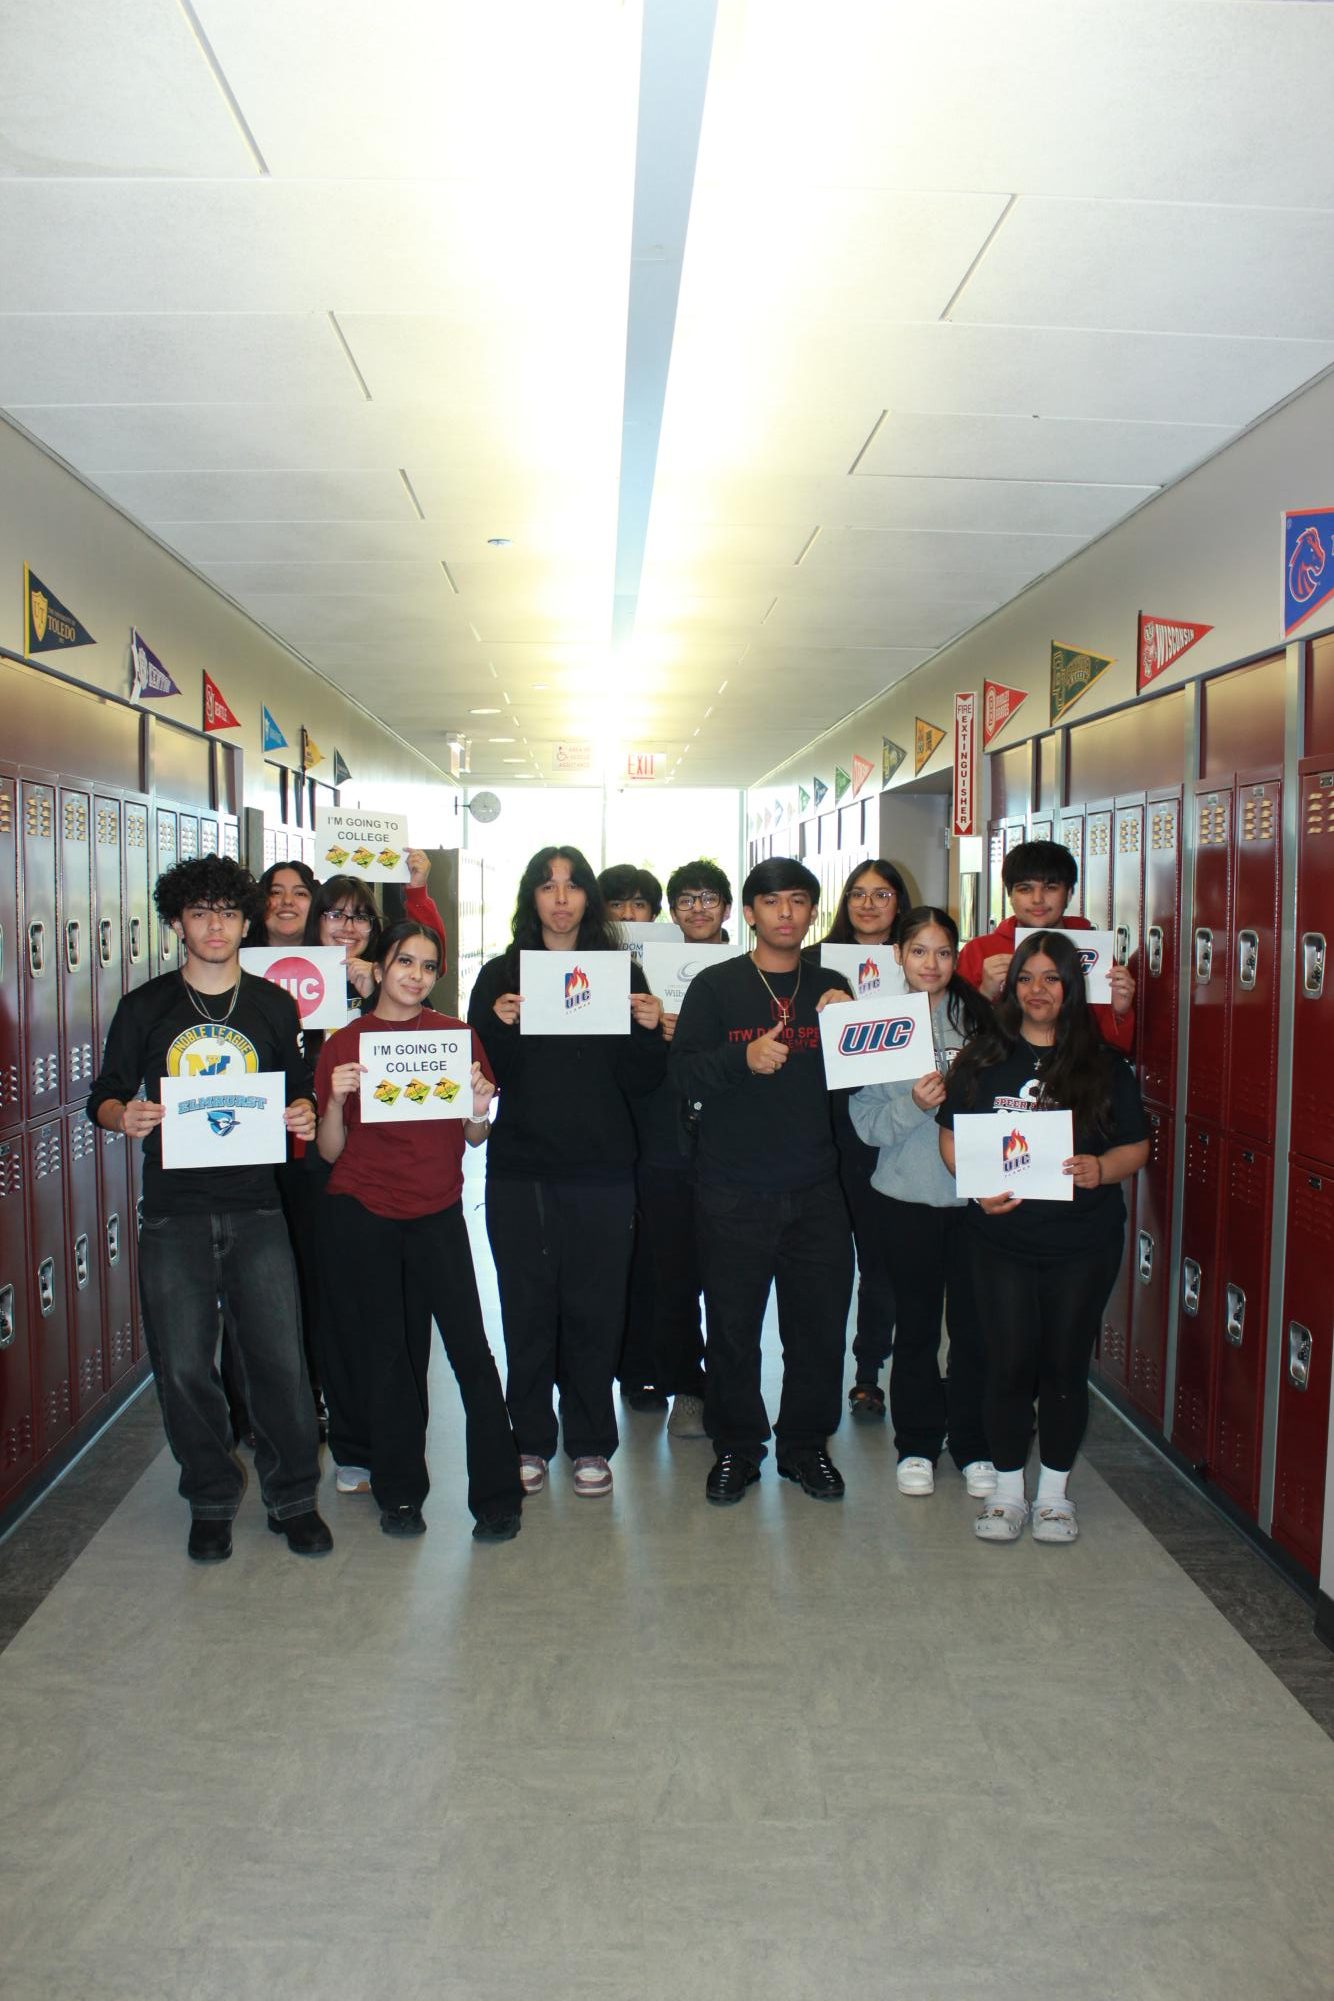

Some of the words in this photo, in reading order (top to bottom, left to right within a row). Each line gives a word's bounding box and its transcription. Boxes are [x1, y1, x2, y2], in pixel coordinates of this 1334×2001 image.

[47, 615, 76, 641] TOLEDO
[1155, 623, 1194, 670] WISCONSIN
[957, 704, 972, 714] FIRE
[960, 715, 968, 824] EXTINGUISHER
[328, 816, 342, 826] I'M
[346, 818, 382, 829] GOING
[385, 821, 399, 831] TO
[338, 831, 390, 843] COLLEGE
[565, 989, 591, 1009] UIC
[174, 1026, 208, 1052] NOBLE
[211, 1027, 253, 1055] LEAGUE
[729, 1028, 753, 1042] ITW
[840, 1018, 914, 1055] UIC
[373, 1045, 391, 1056] I'M
[395, 1044, 437, 1055] GOING
[440, 1043, 458, 1054] TO
[386, 1061, 447, 1072] COLLEGE
[178, 1095, 268, 1115] ELMHURST
[994, 1097, 1028, 1110] SPEER
[1003, 1153, 1031, 1172] UIC
